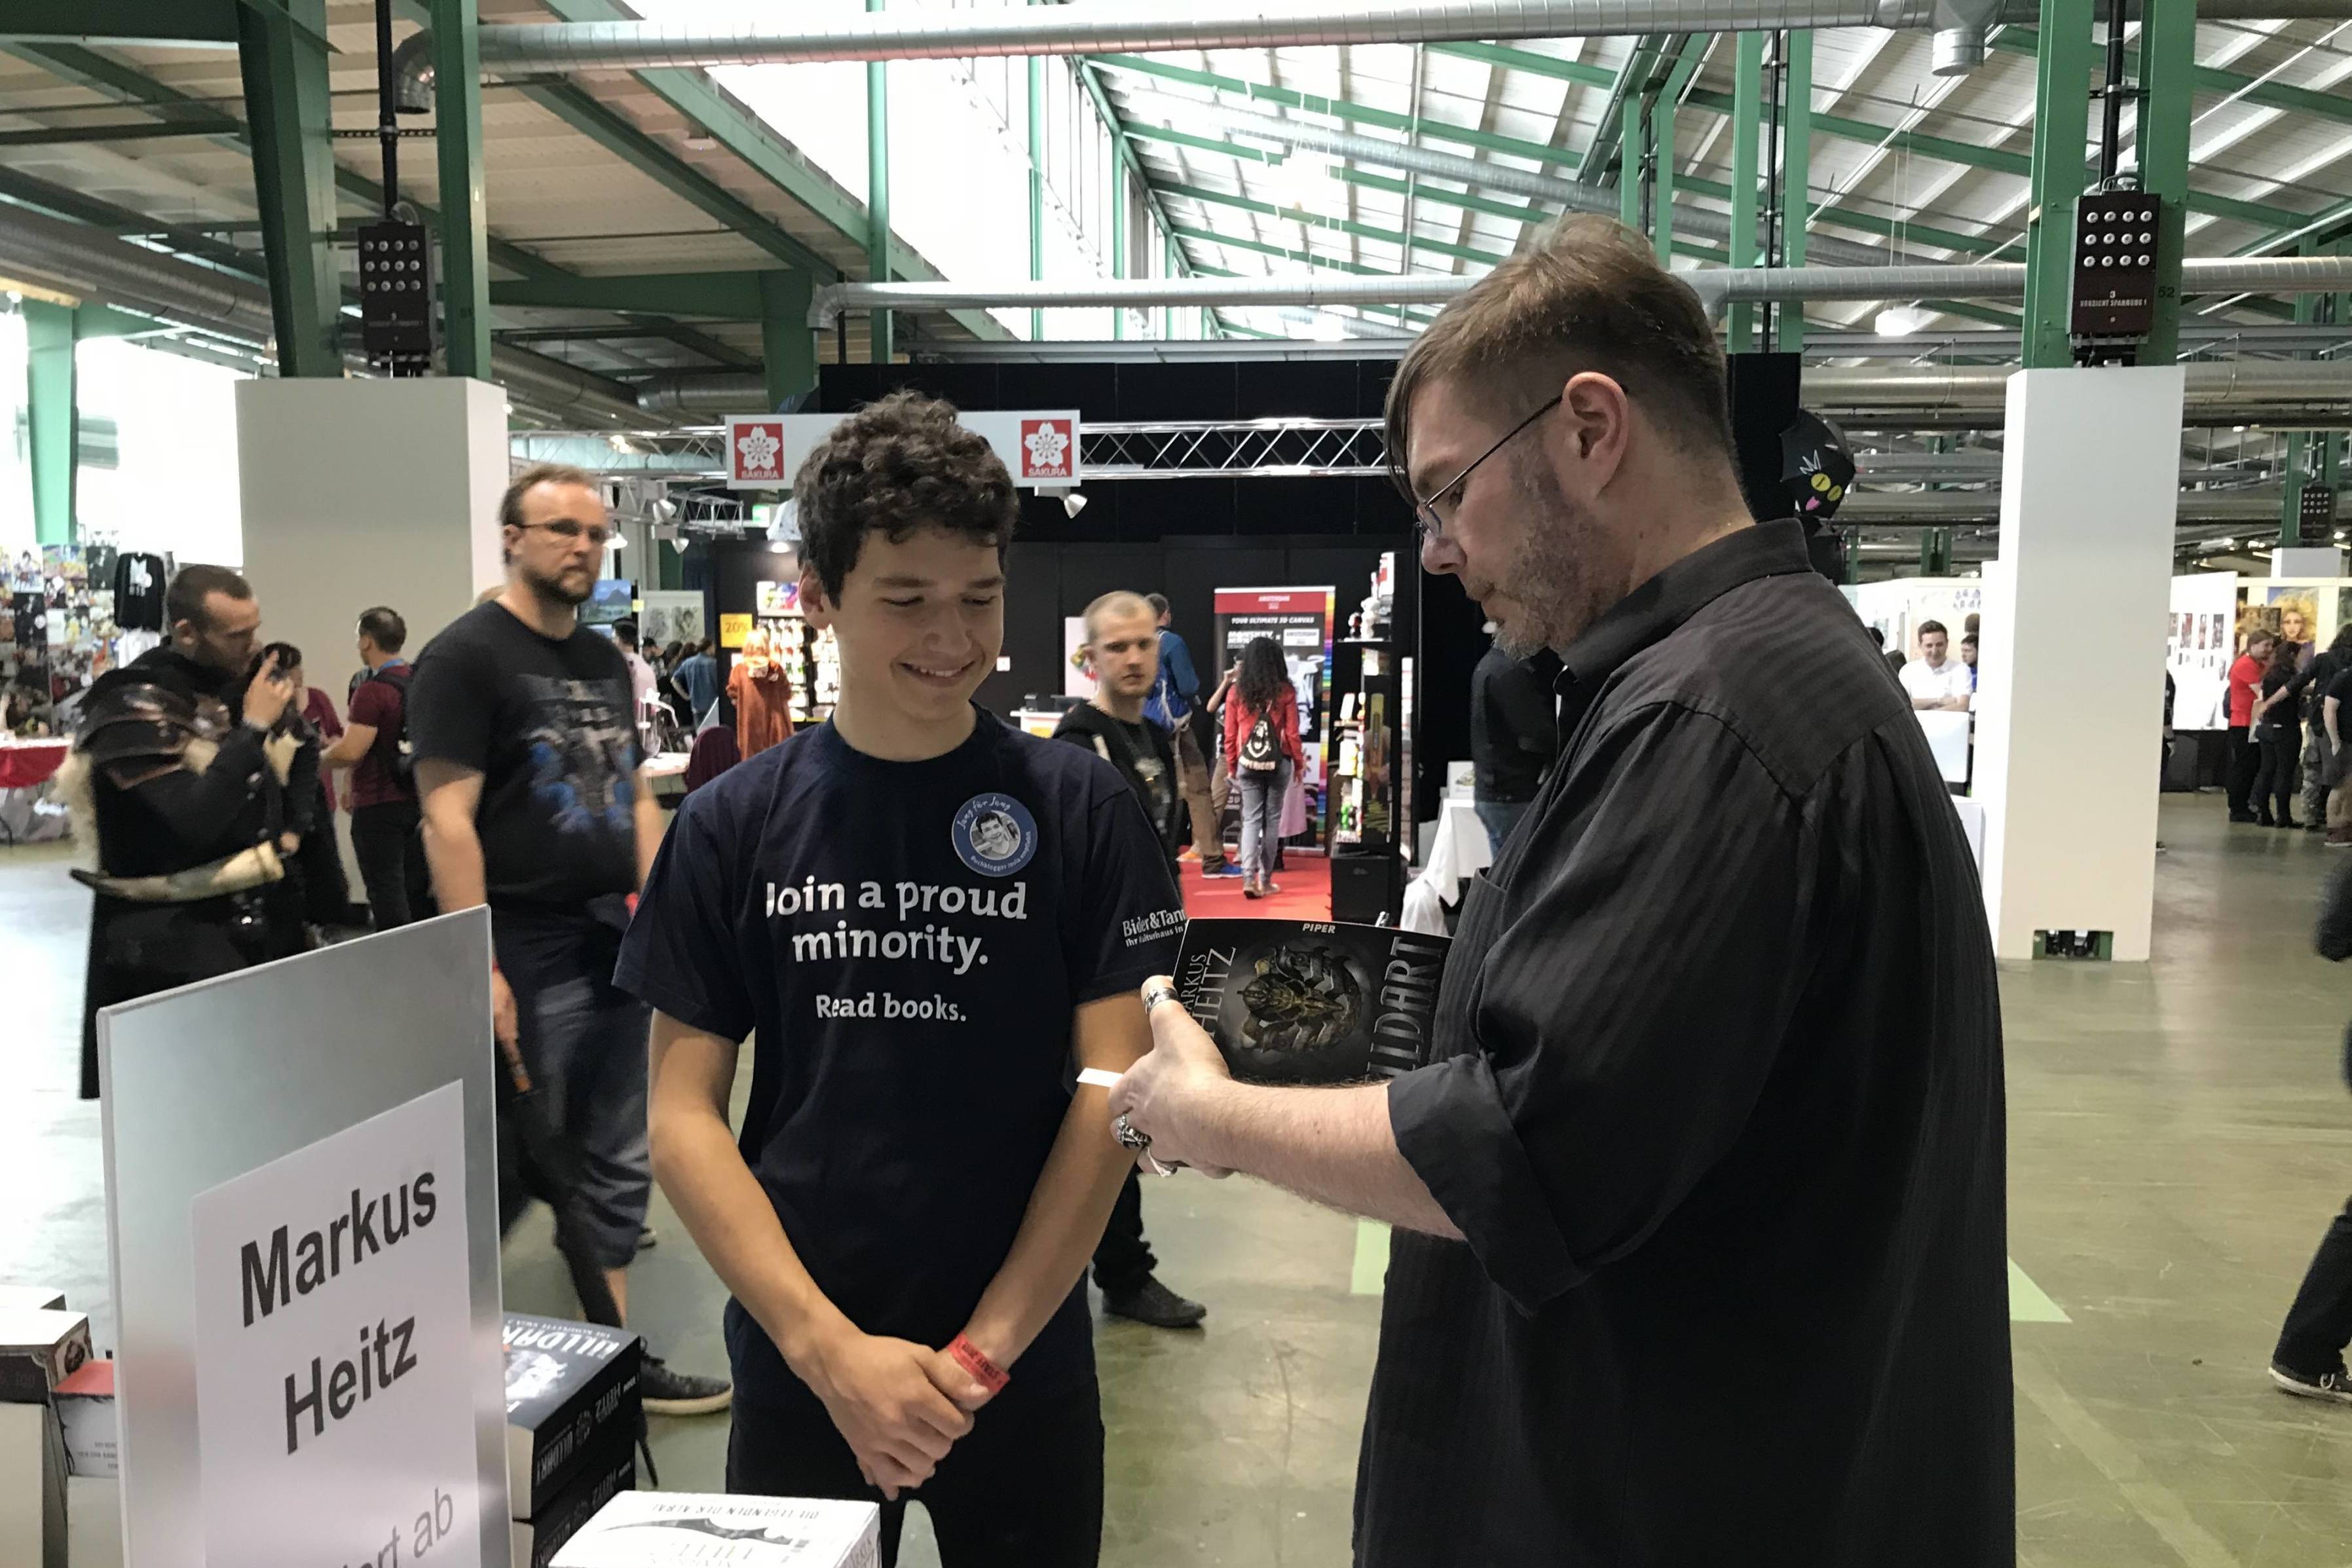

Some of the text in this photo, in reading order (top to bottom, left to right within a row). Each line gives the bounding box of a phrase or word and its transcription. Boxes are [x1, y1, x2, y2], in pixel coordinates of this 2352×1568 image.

[741, 470, 779, 479] SAKURA
[1028, 467, 1067, 477] SAKURA
[989, 796, 1011, 811] Jung
[766, 874, 1028, 922] Join a proud
[791, 919, 989, 976] minority.
[1125, 938, 1138, 947] Ihr
[1301, 922, 1336, 935] PIPER
[1180, 952, 1206, 1013] ARKUS
[1366, 935, 1442, 1077] LLDART
[815, 992, 967, 1022] Read books.
[240, 1171, 438, 1328] Markus
[284, 1315, 419, 1455] Heitz
[413, 1486, 453, 1559] ab
